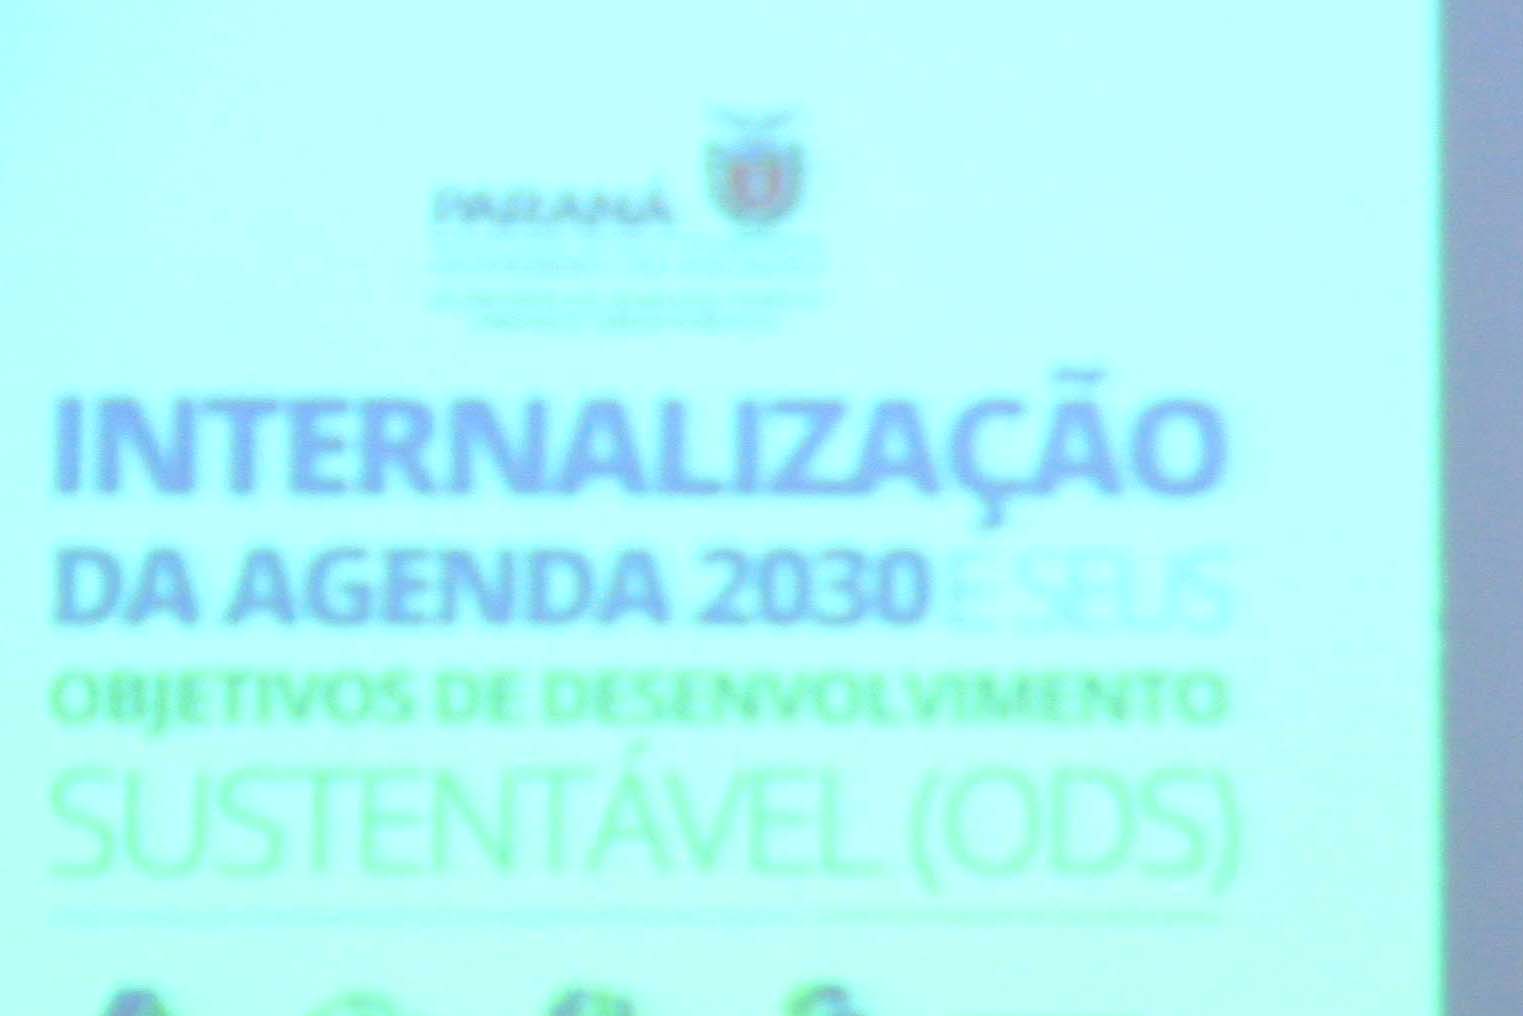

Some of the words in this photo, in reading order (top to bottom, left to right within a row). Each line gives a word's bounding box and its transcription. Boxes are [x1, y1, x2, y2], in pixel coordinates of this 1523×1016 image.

[54, 366, 1229, 526] INTERNALIZAÇÃO
[55, 549, 198, 626] DA
[225, 549, 669, 626] AGENDA
[699, 549, 932, 626] 2030
[50, 670, 415, 735] OBJETIVOS
[434, 672, 519, 725] DE
[544, 671, 1228, 725] DESENVOLVIMENTO
[48, 743, 881, 880] SUSTENTÁVEL
[909, 764, 1243, 894] (ODS)
